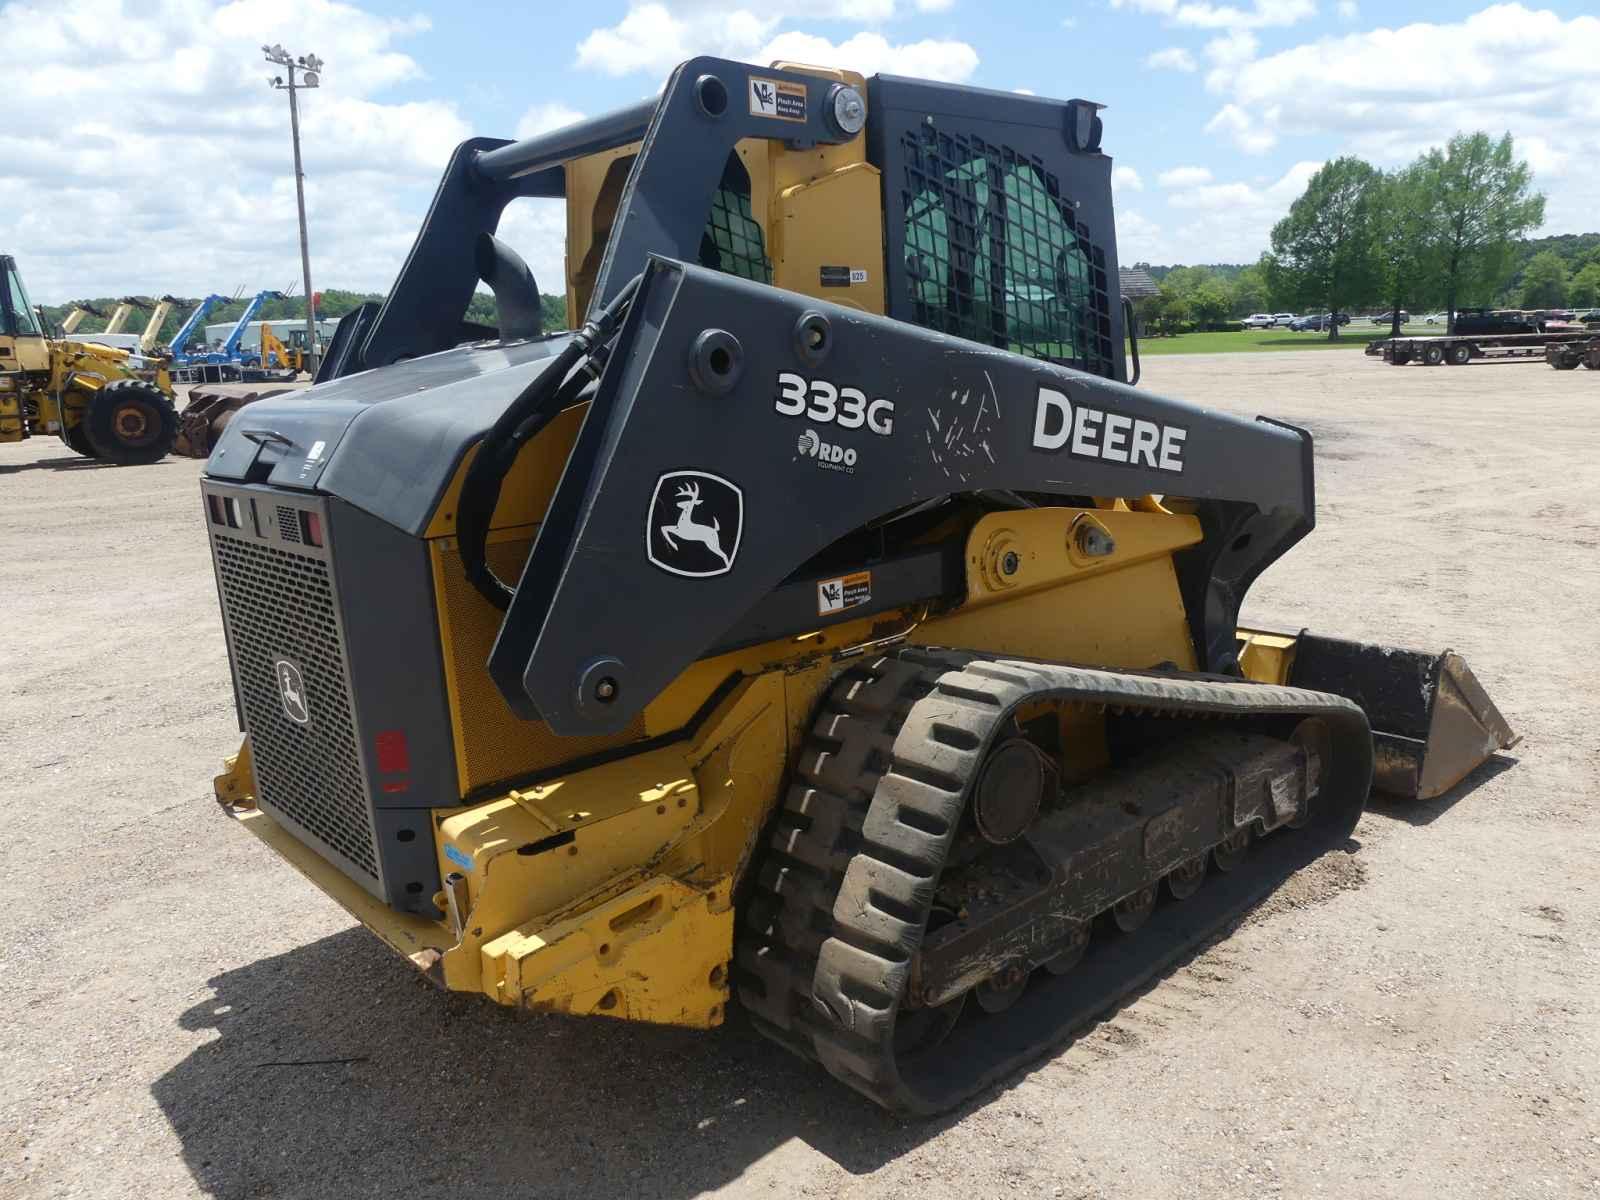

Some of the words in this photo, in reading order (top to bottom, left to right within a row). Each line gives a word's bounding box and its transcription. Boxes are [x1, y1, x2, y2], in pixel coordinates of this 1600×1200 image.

[776, 373, 895, 435] 333G
[1033, 387, 1187, 472] DEERE
[818, 442, 857, 466] RDO
